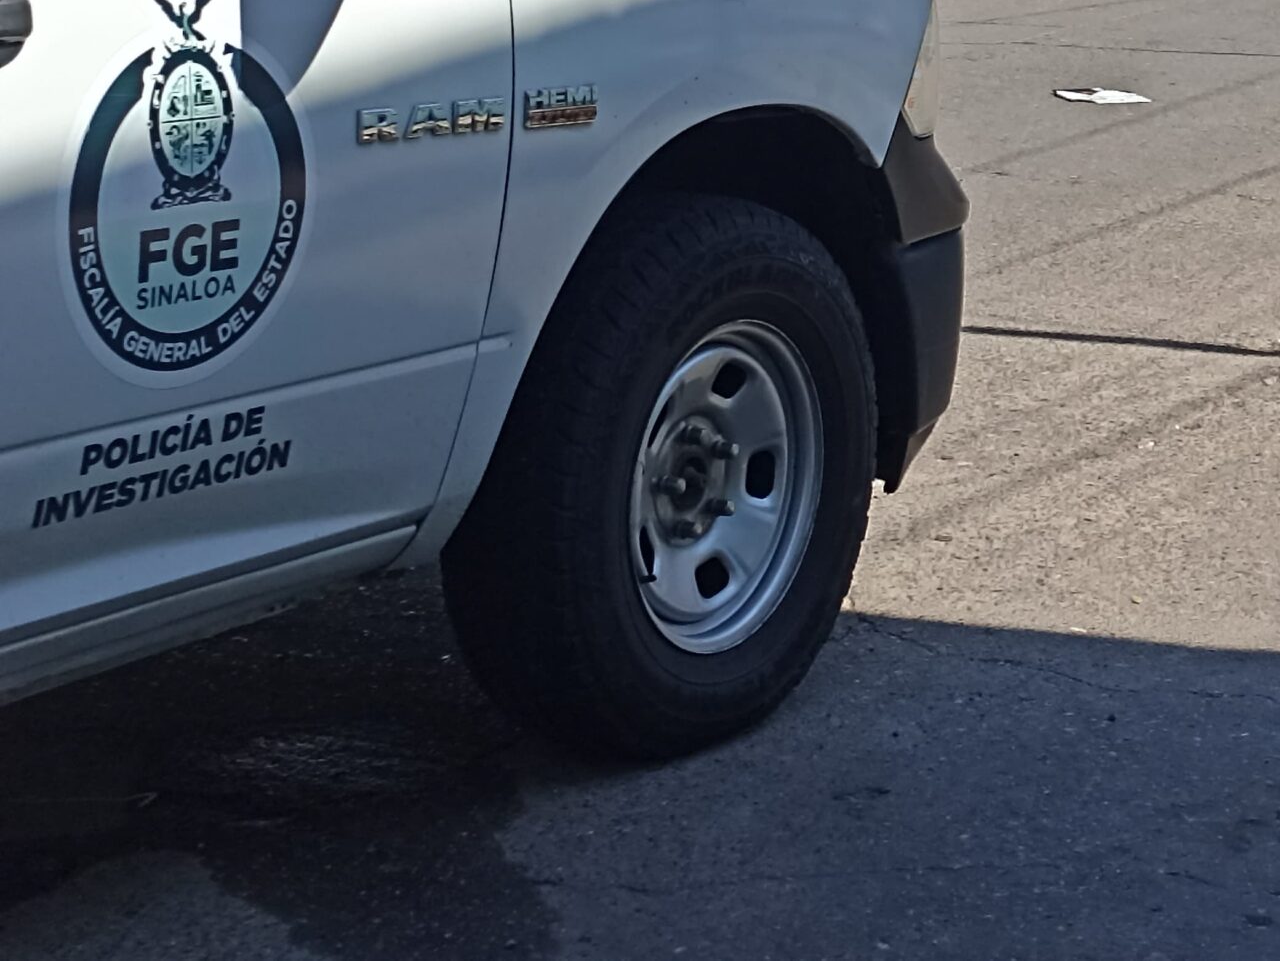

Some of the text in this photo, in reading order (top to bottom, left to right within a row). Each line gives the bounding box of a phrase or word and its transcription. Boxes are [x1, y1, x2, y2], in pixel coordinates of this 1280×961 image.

[357, 97, 504, 146] RAM
[525, 83, 598, 109] HEMI
[77, 199, 298, 363] FISCALÍA GENERAL DEL ESTADO
[138, 218, 241, 283] FGE
[136, 275, 236, 310] SINALOA
[79, 405, 266, 476] POLICÍA DE
[31, 439, 292, 529] INVESTIGACIÓN
